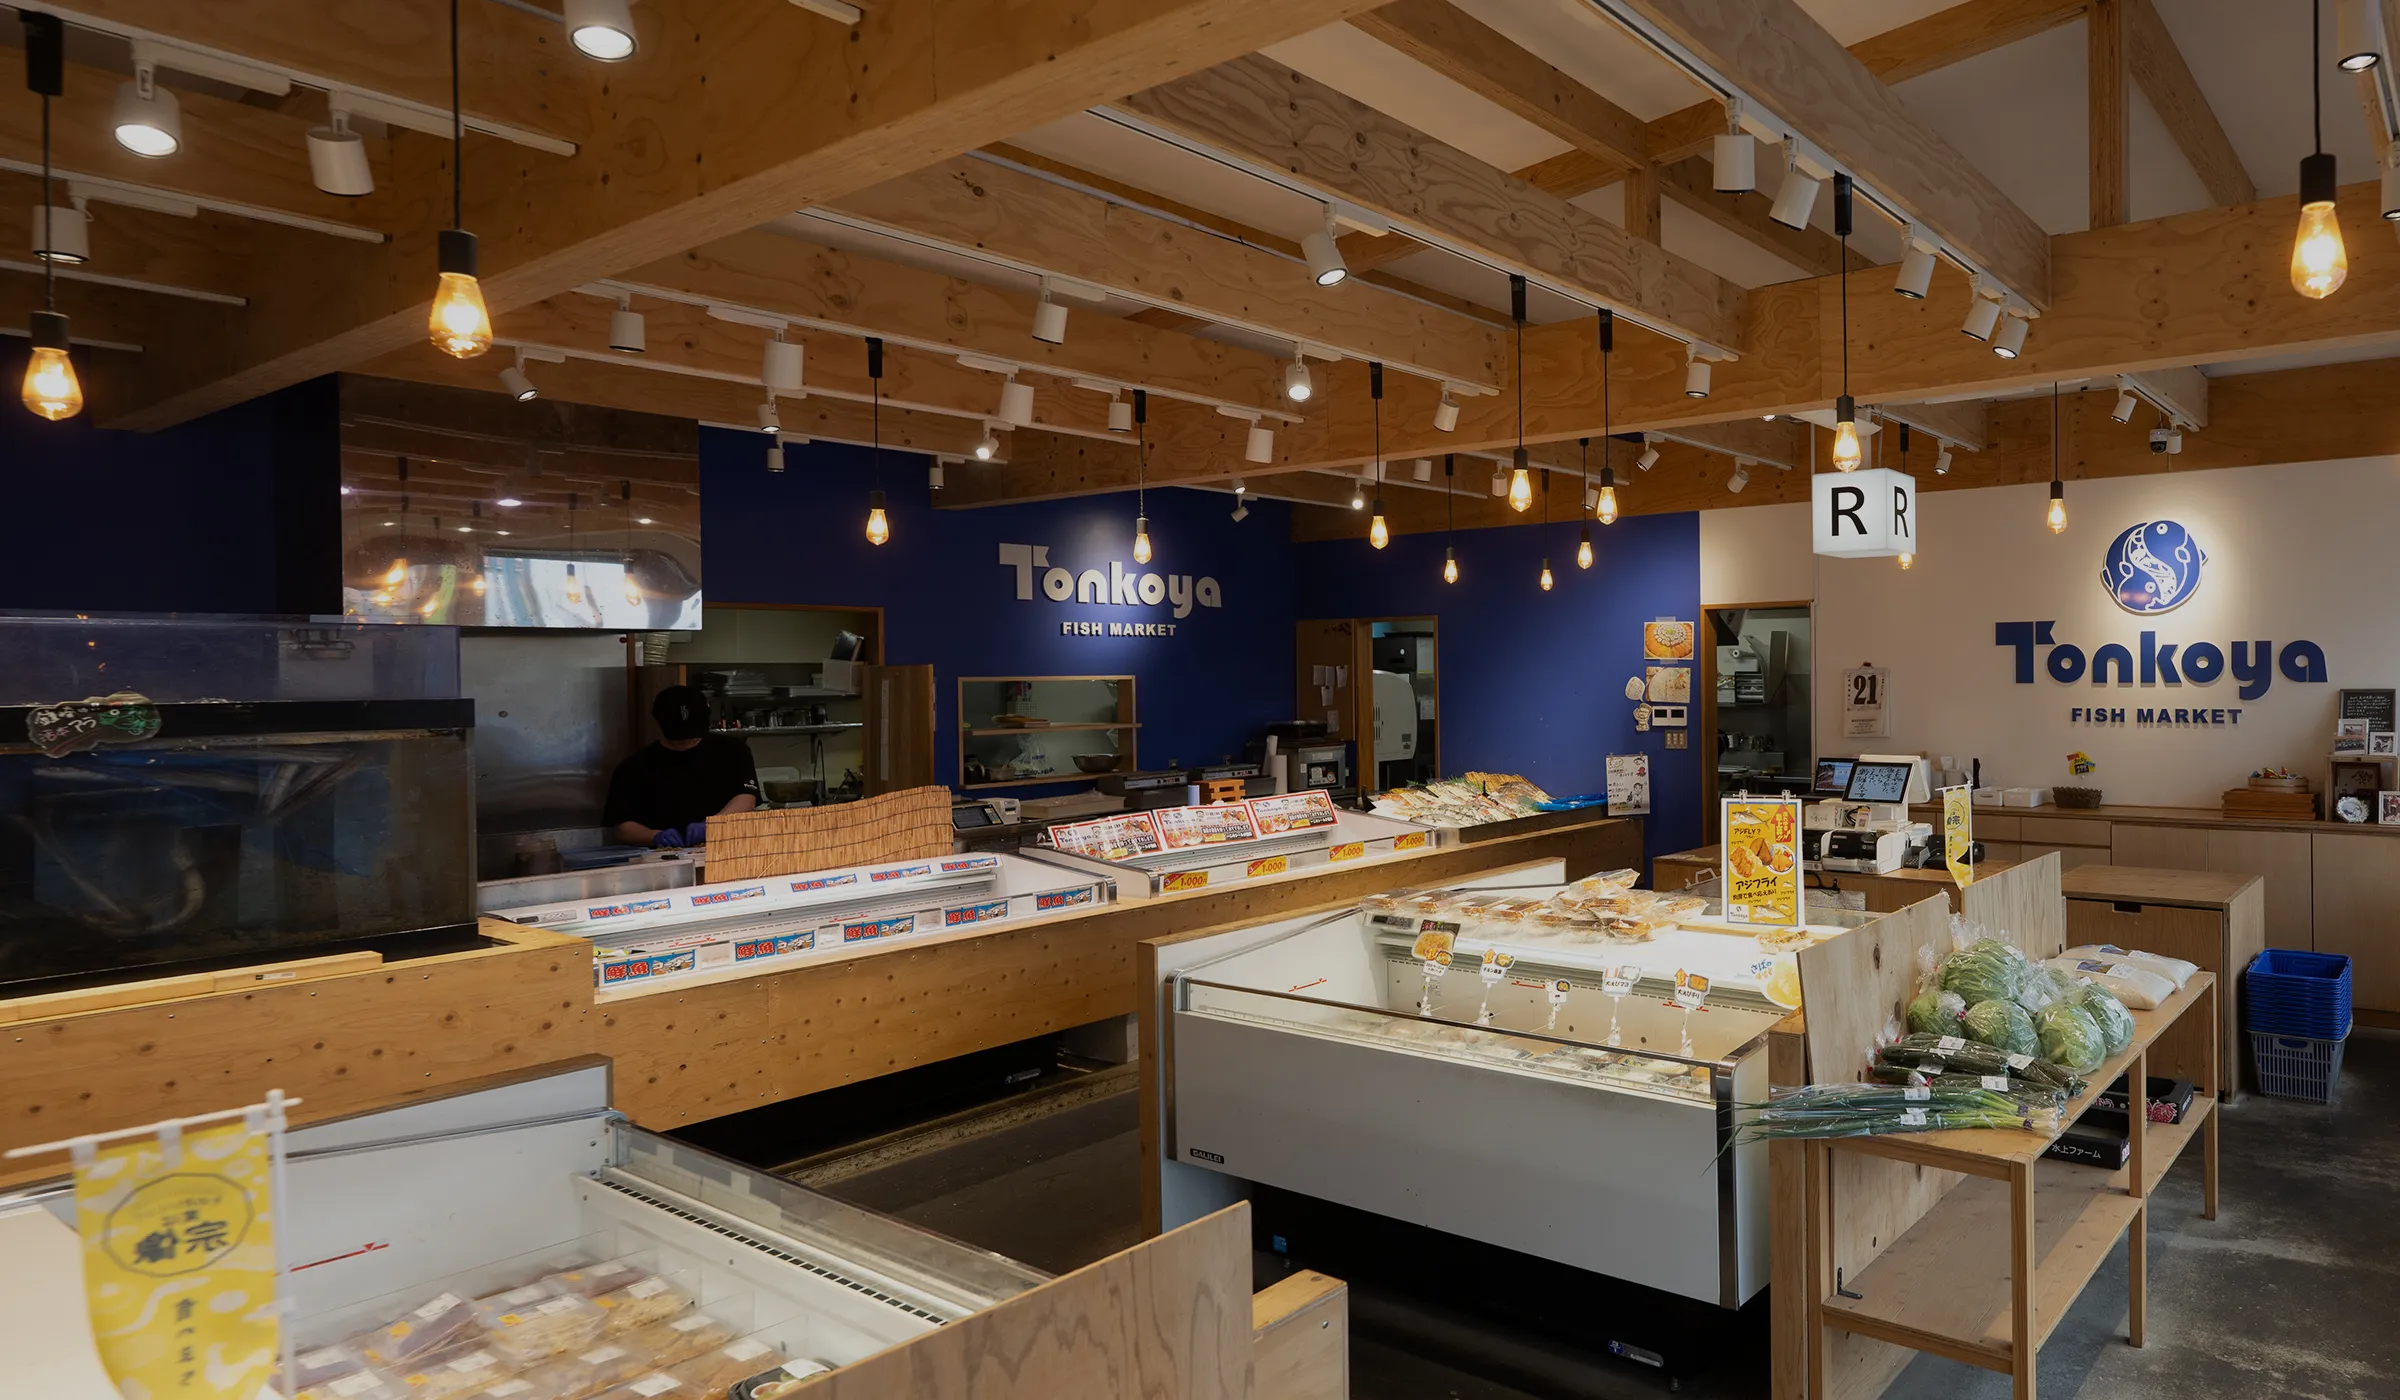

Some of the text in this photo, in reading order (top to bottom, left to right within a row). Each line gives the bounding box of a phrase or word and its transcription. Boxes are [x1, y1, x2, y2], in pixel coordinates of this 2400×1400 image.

[1831, 486, 1868, 536] R
[1894, 485, 1909, 538] R
[998, 543, 1222, 619] Tonkoya
[1061, 621, 1177, 638] FISH MARKET
[1995, 620, 2329, 701] Tonkoya
[1853, 674, 1877, 705] 21
[2071, 707, 2243, 725] FISH MARKET
[1736, 876, 1778, 891] アジフライ
[1750, 959, 1773, 975] さばの
[1192, 1149, 1222, 1163] GALILEI
